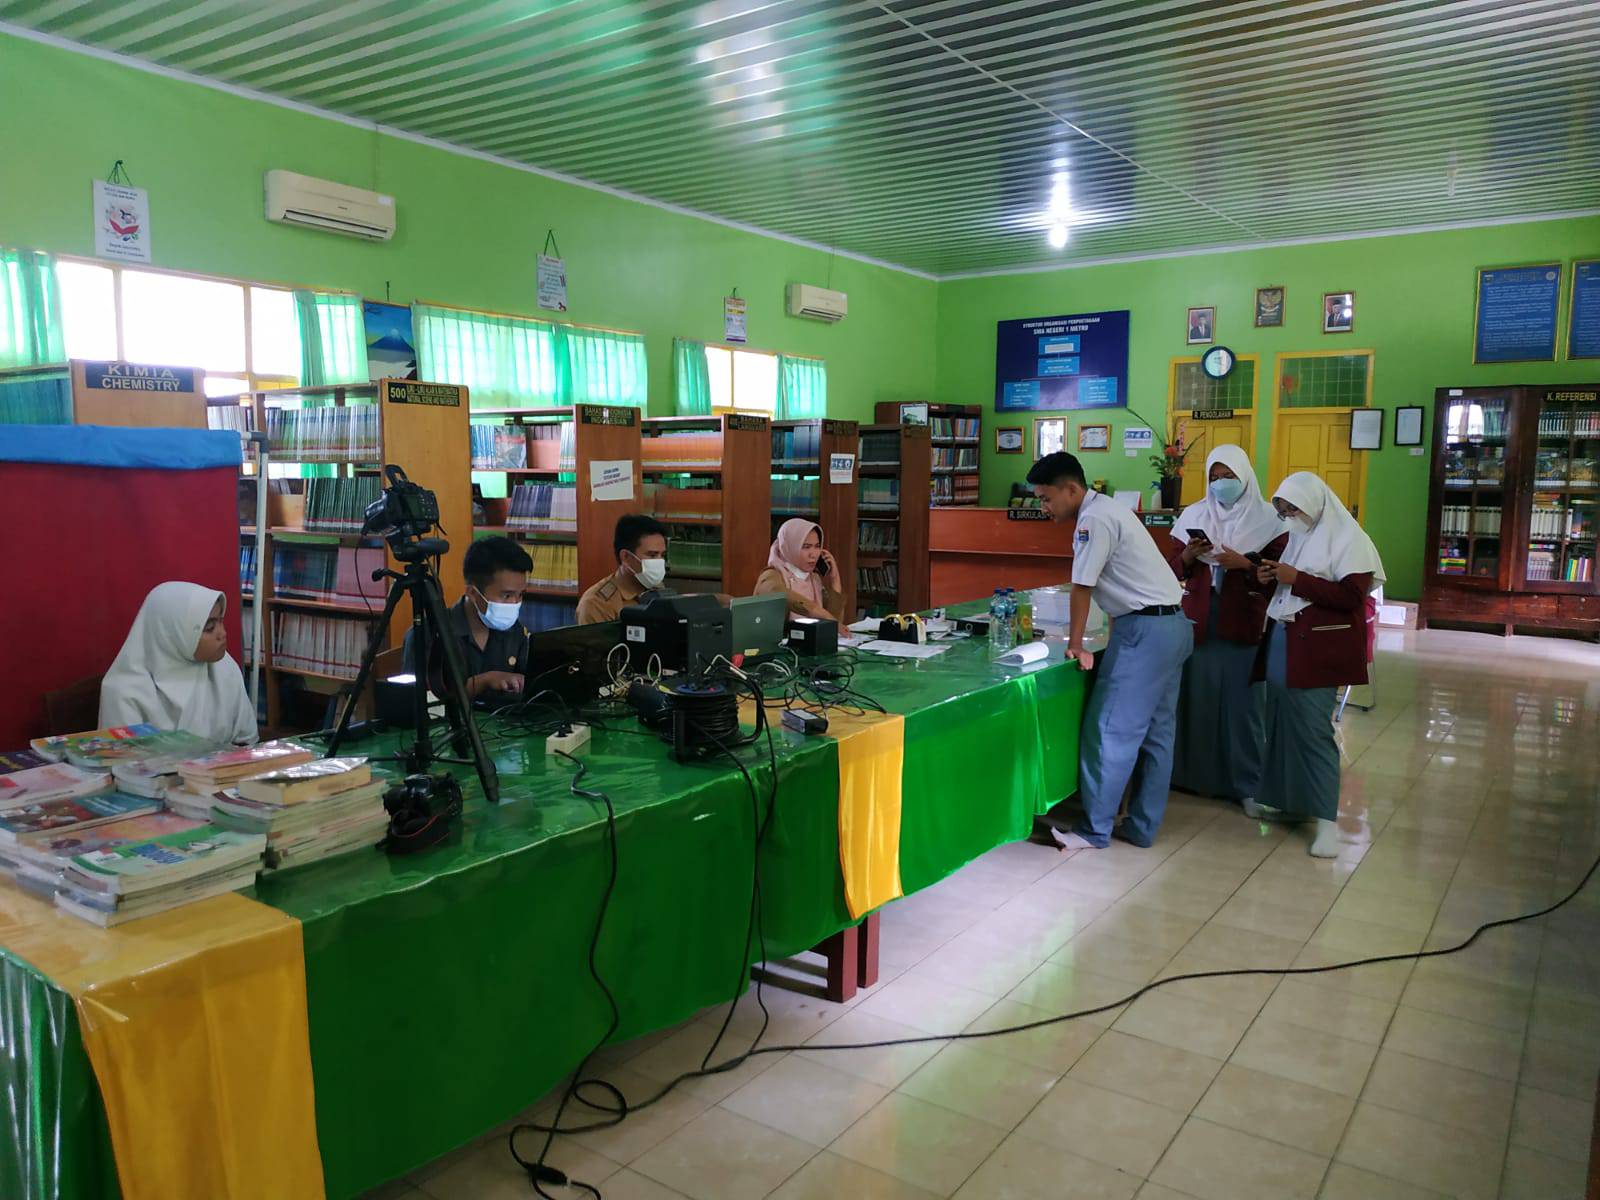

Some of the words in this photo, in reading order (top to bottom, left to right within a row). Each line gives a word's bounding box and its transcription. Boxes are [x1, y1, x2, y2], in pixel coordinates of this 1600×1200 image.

[1046, 326, 1065, 334] NEGERI
[108, 364, 174, 377] KIMIA
[101, 377, 180, 391] CHEMISTRY
[390, 387, 406, 399] 500
[1555, 391, 1597, 401] REFERENSI
